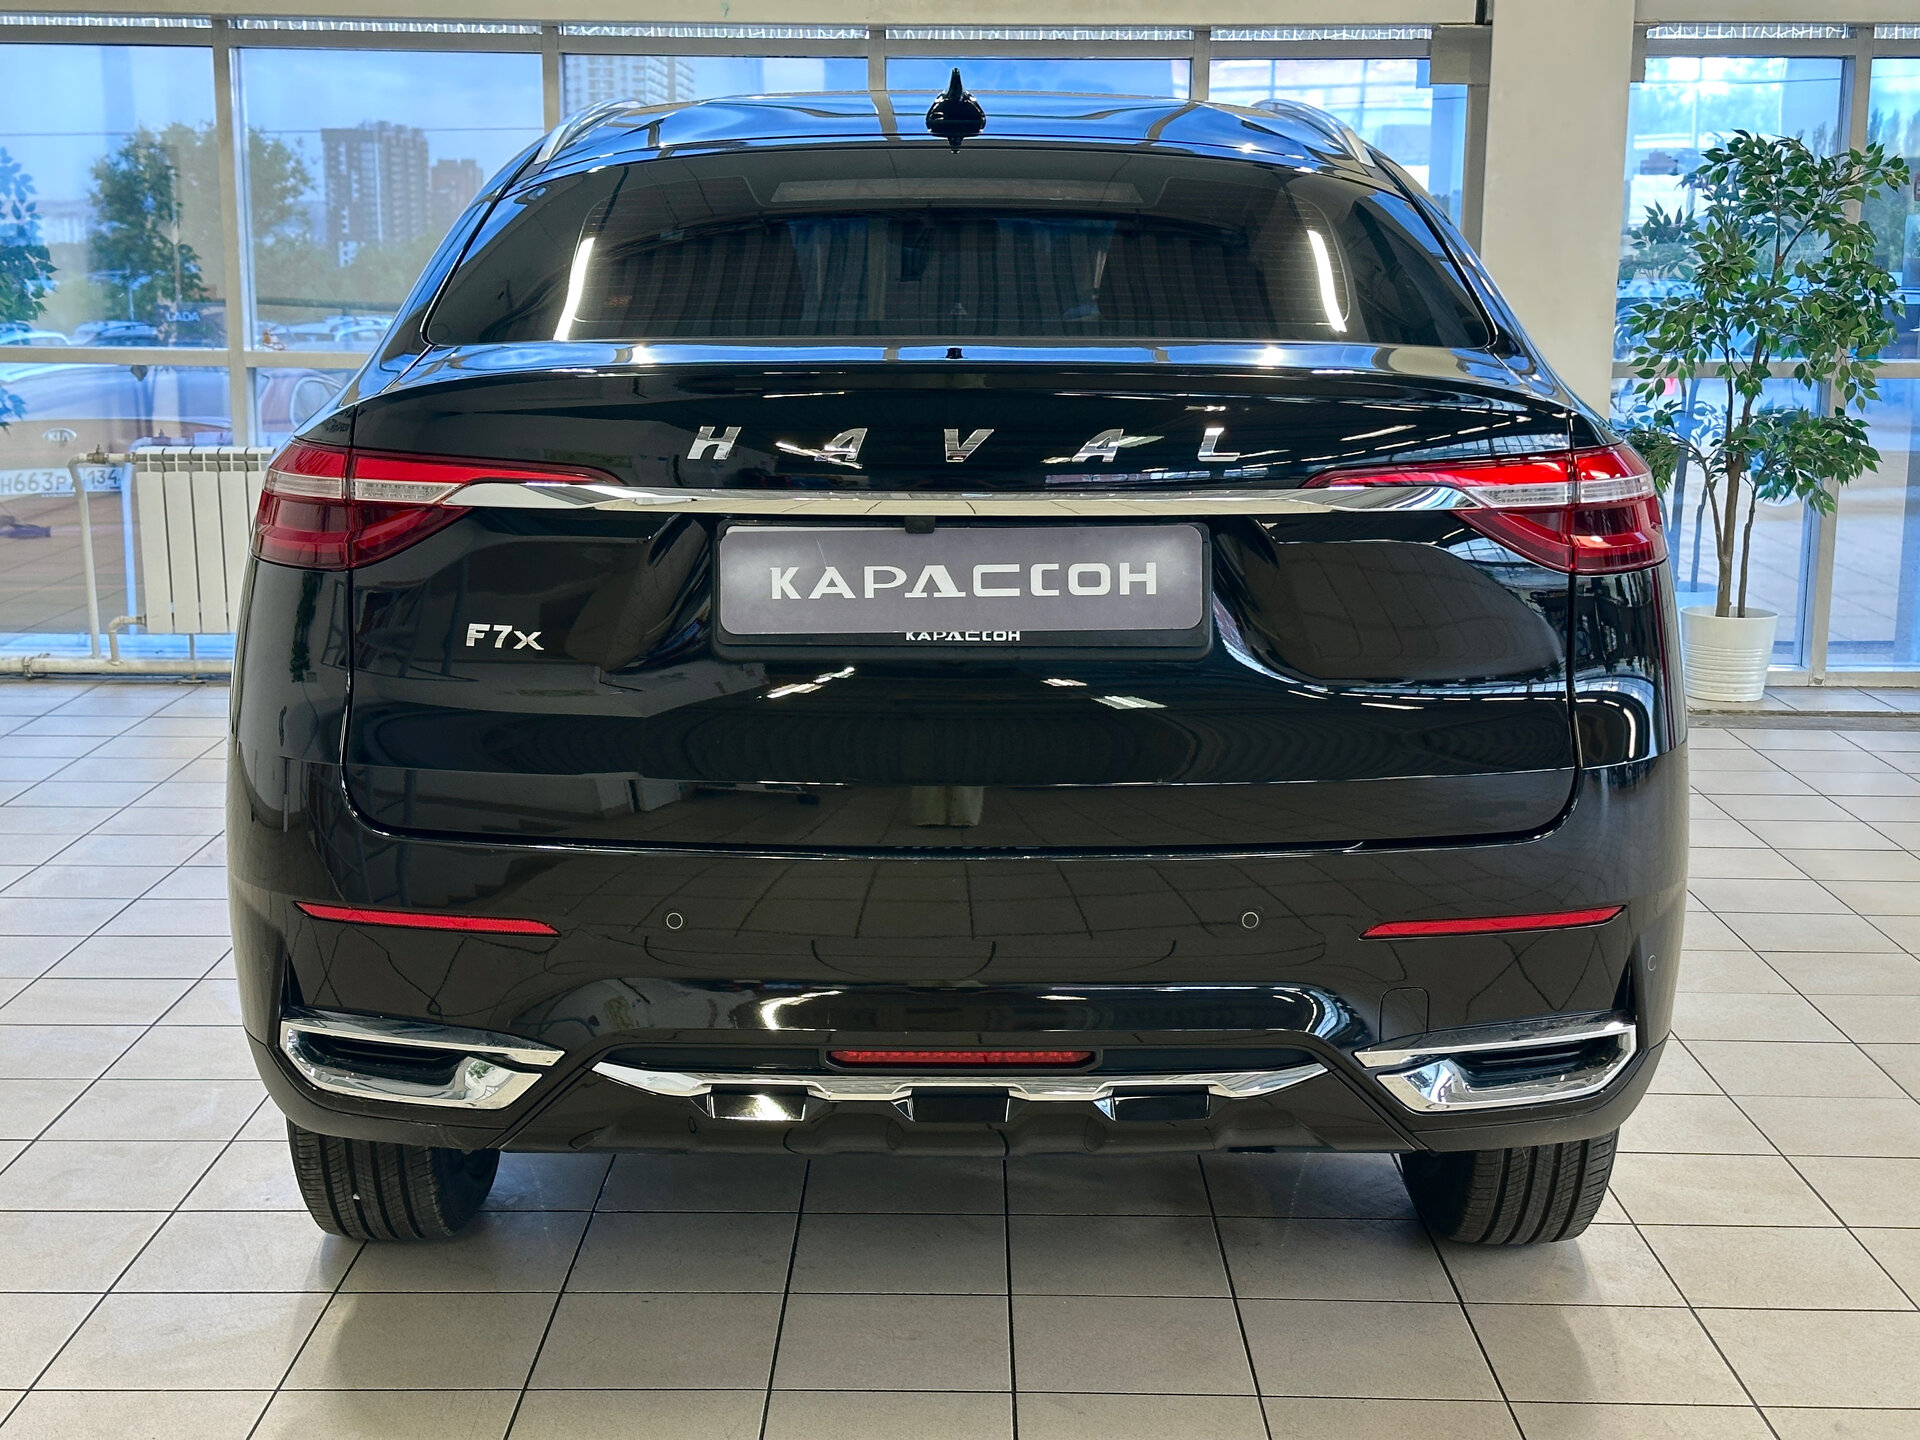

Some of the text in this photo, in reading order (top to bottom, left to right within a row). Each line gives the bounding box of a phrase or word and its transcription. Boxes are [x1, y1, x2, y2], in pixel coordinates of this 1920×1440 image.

[165, 311, 201, 322] LADA
[46, 430, 72, 443] KIA
[686, 425, 1241, 463] HAVAL
[87, 469, 118, 485] 134
